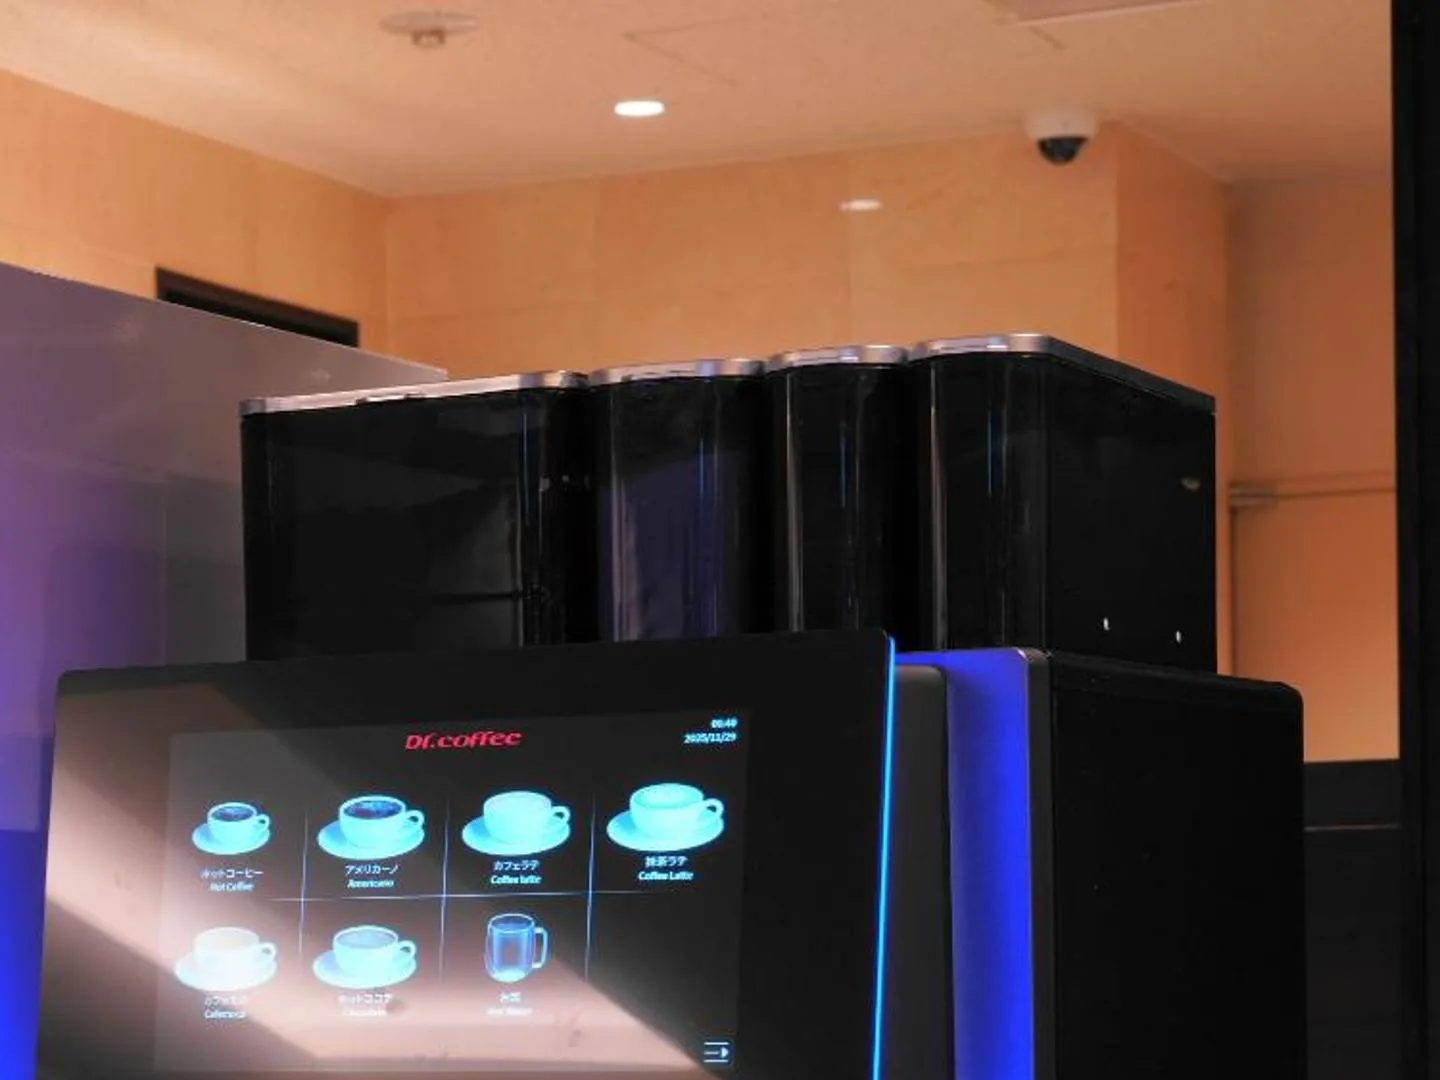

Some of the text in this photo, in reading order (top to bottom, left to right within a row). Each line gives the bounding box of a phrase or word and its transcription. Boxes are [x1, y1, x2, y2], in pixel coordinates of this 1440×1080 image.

[344, 864, 400, 876] アメリカーノ
[493, 860, 540, 871] カフェラテ
[200, 867, 265, 879] ホットコーヒー
